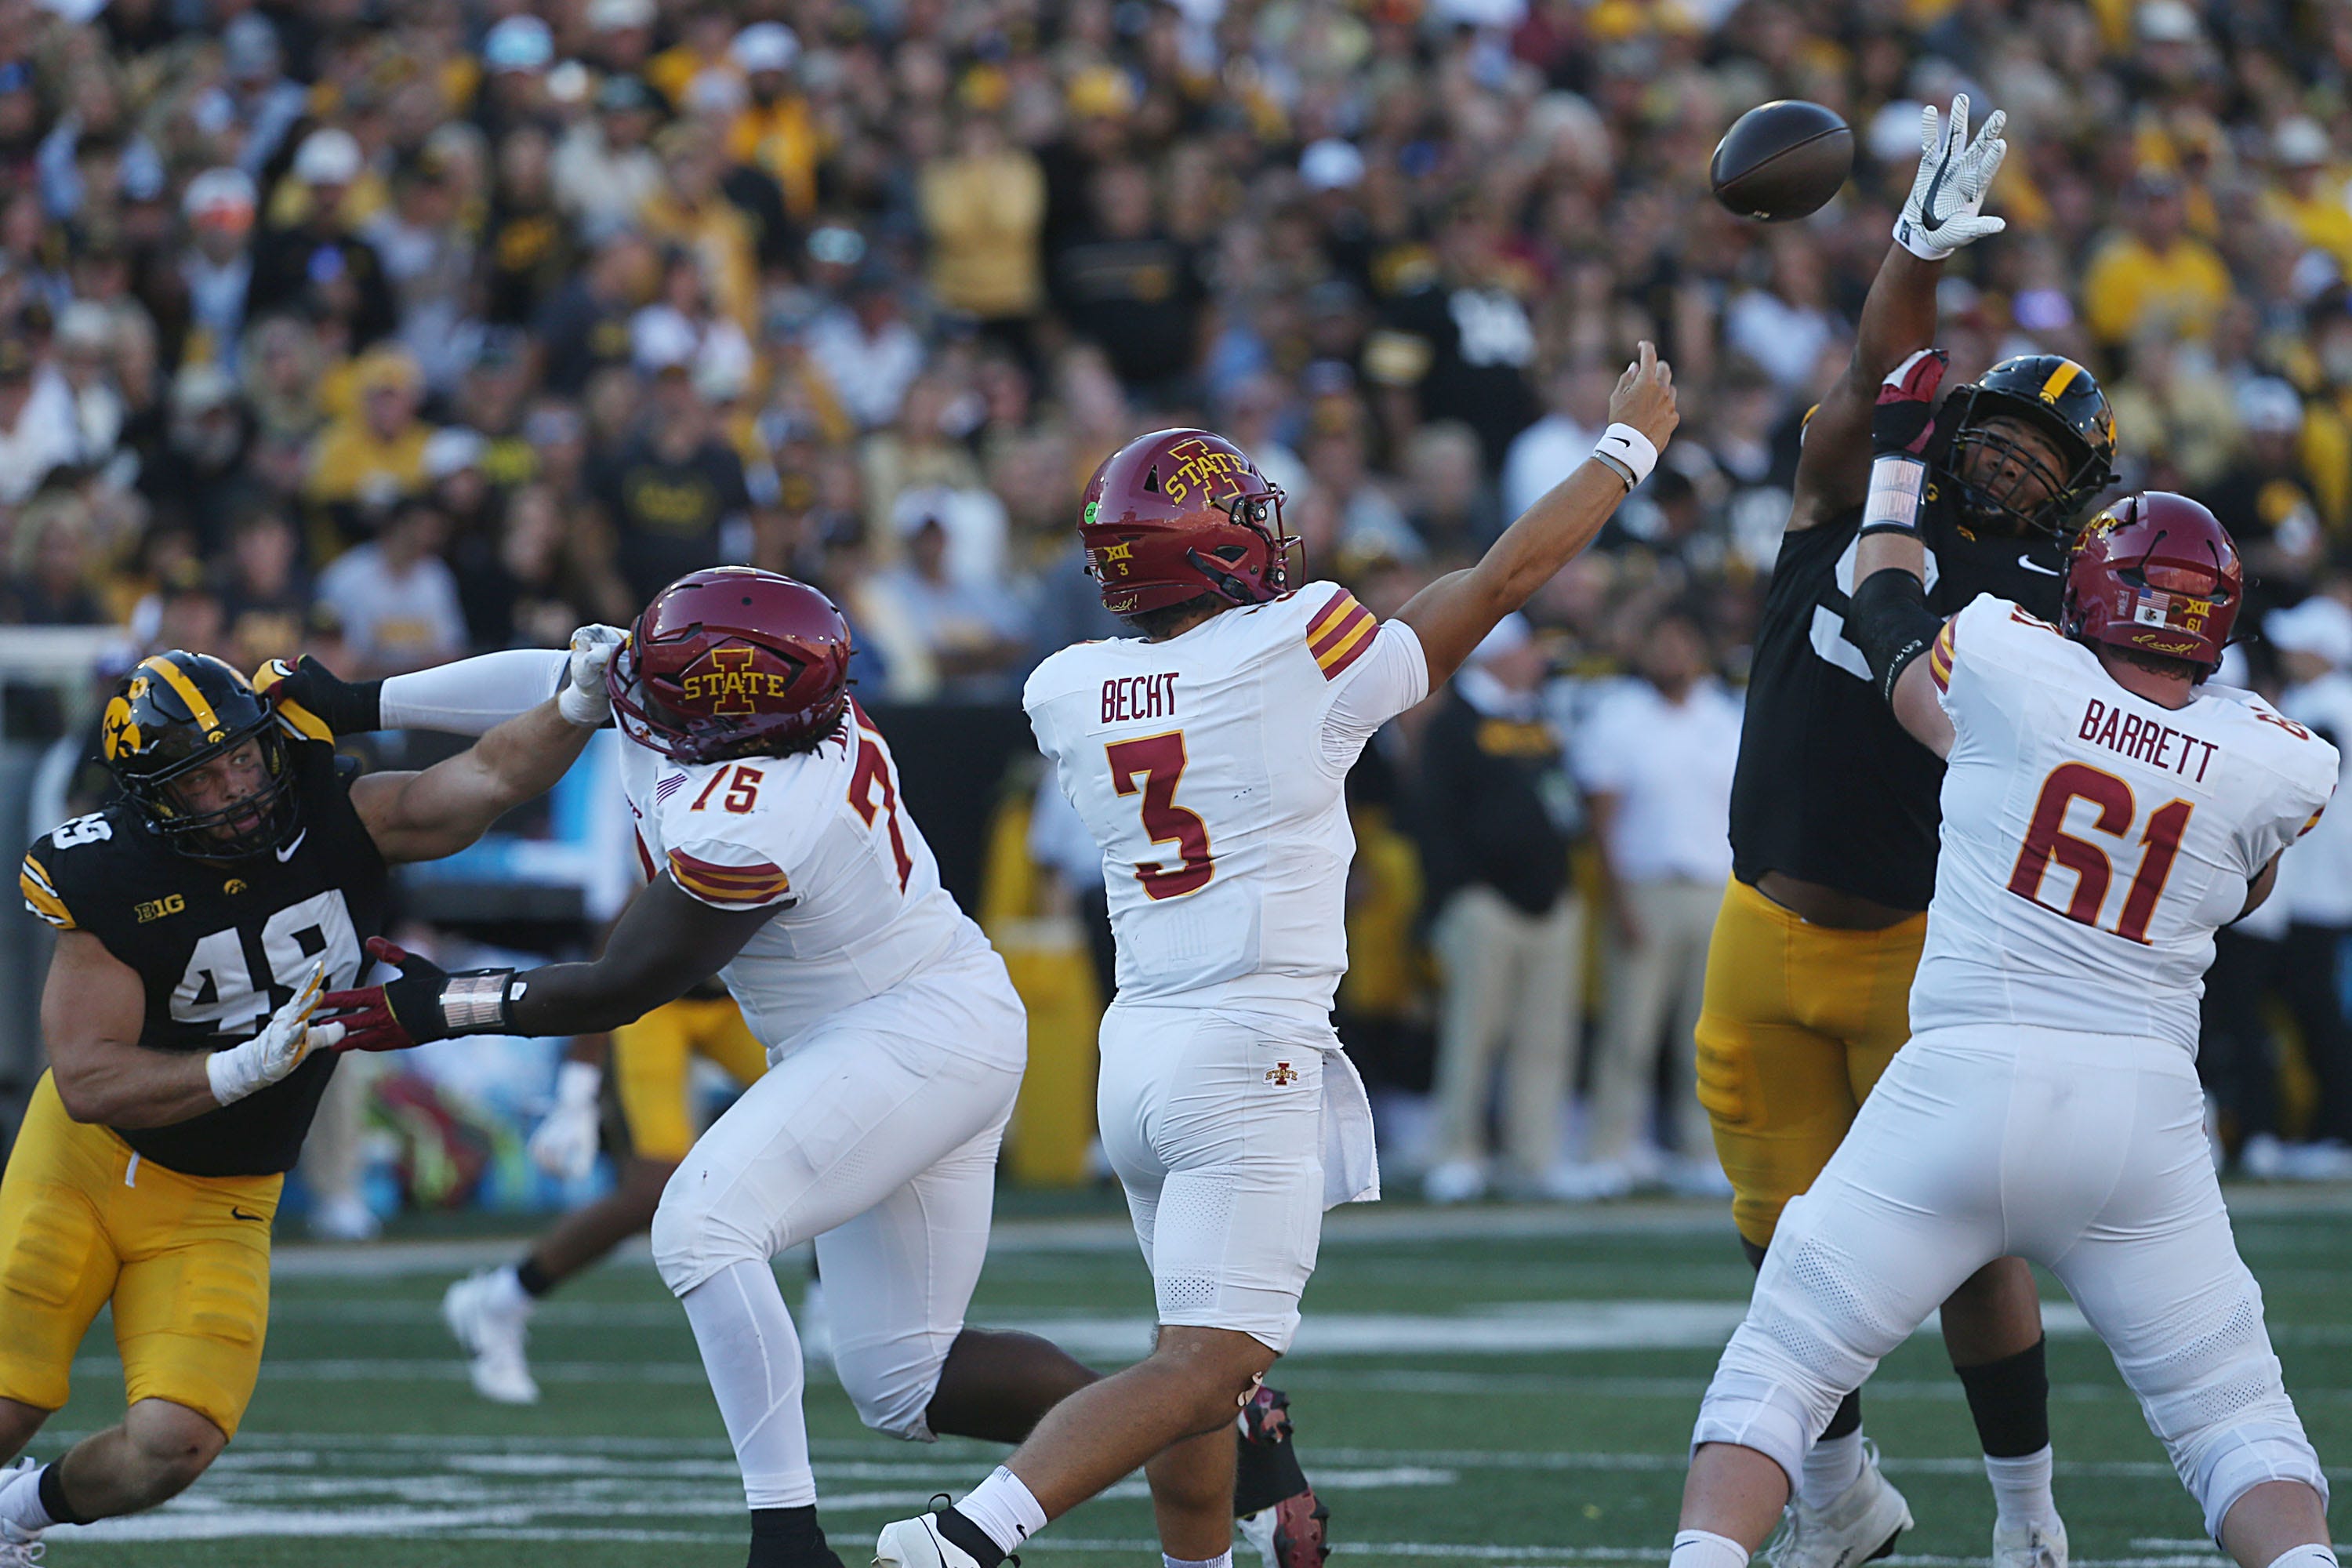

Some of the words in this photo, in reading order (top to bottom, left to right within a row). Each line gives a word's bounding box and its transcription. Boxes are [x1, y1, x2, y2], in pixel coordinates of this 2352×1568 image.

[1165, 453, 1250, 505] STATE
[1103, 542, 1134, 562] XII
[1117, 563, 1129, 576] 3
[2183, 597, 2213, 618] XII
[2186, 618, 2202, 633] 61
[683, 672, 785, 700] STATE
[1101, 672, 1179, 724] BECHT
[2078, 698, 2219, 783] BARRETT
[1104, 728, 1215, 901] 3
[2006, 760, 2194, 946] 61
[169, 887, 362, 1036] 49
